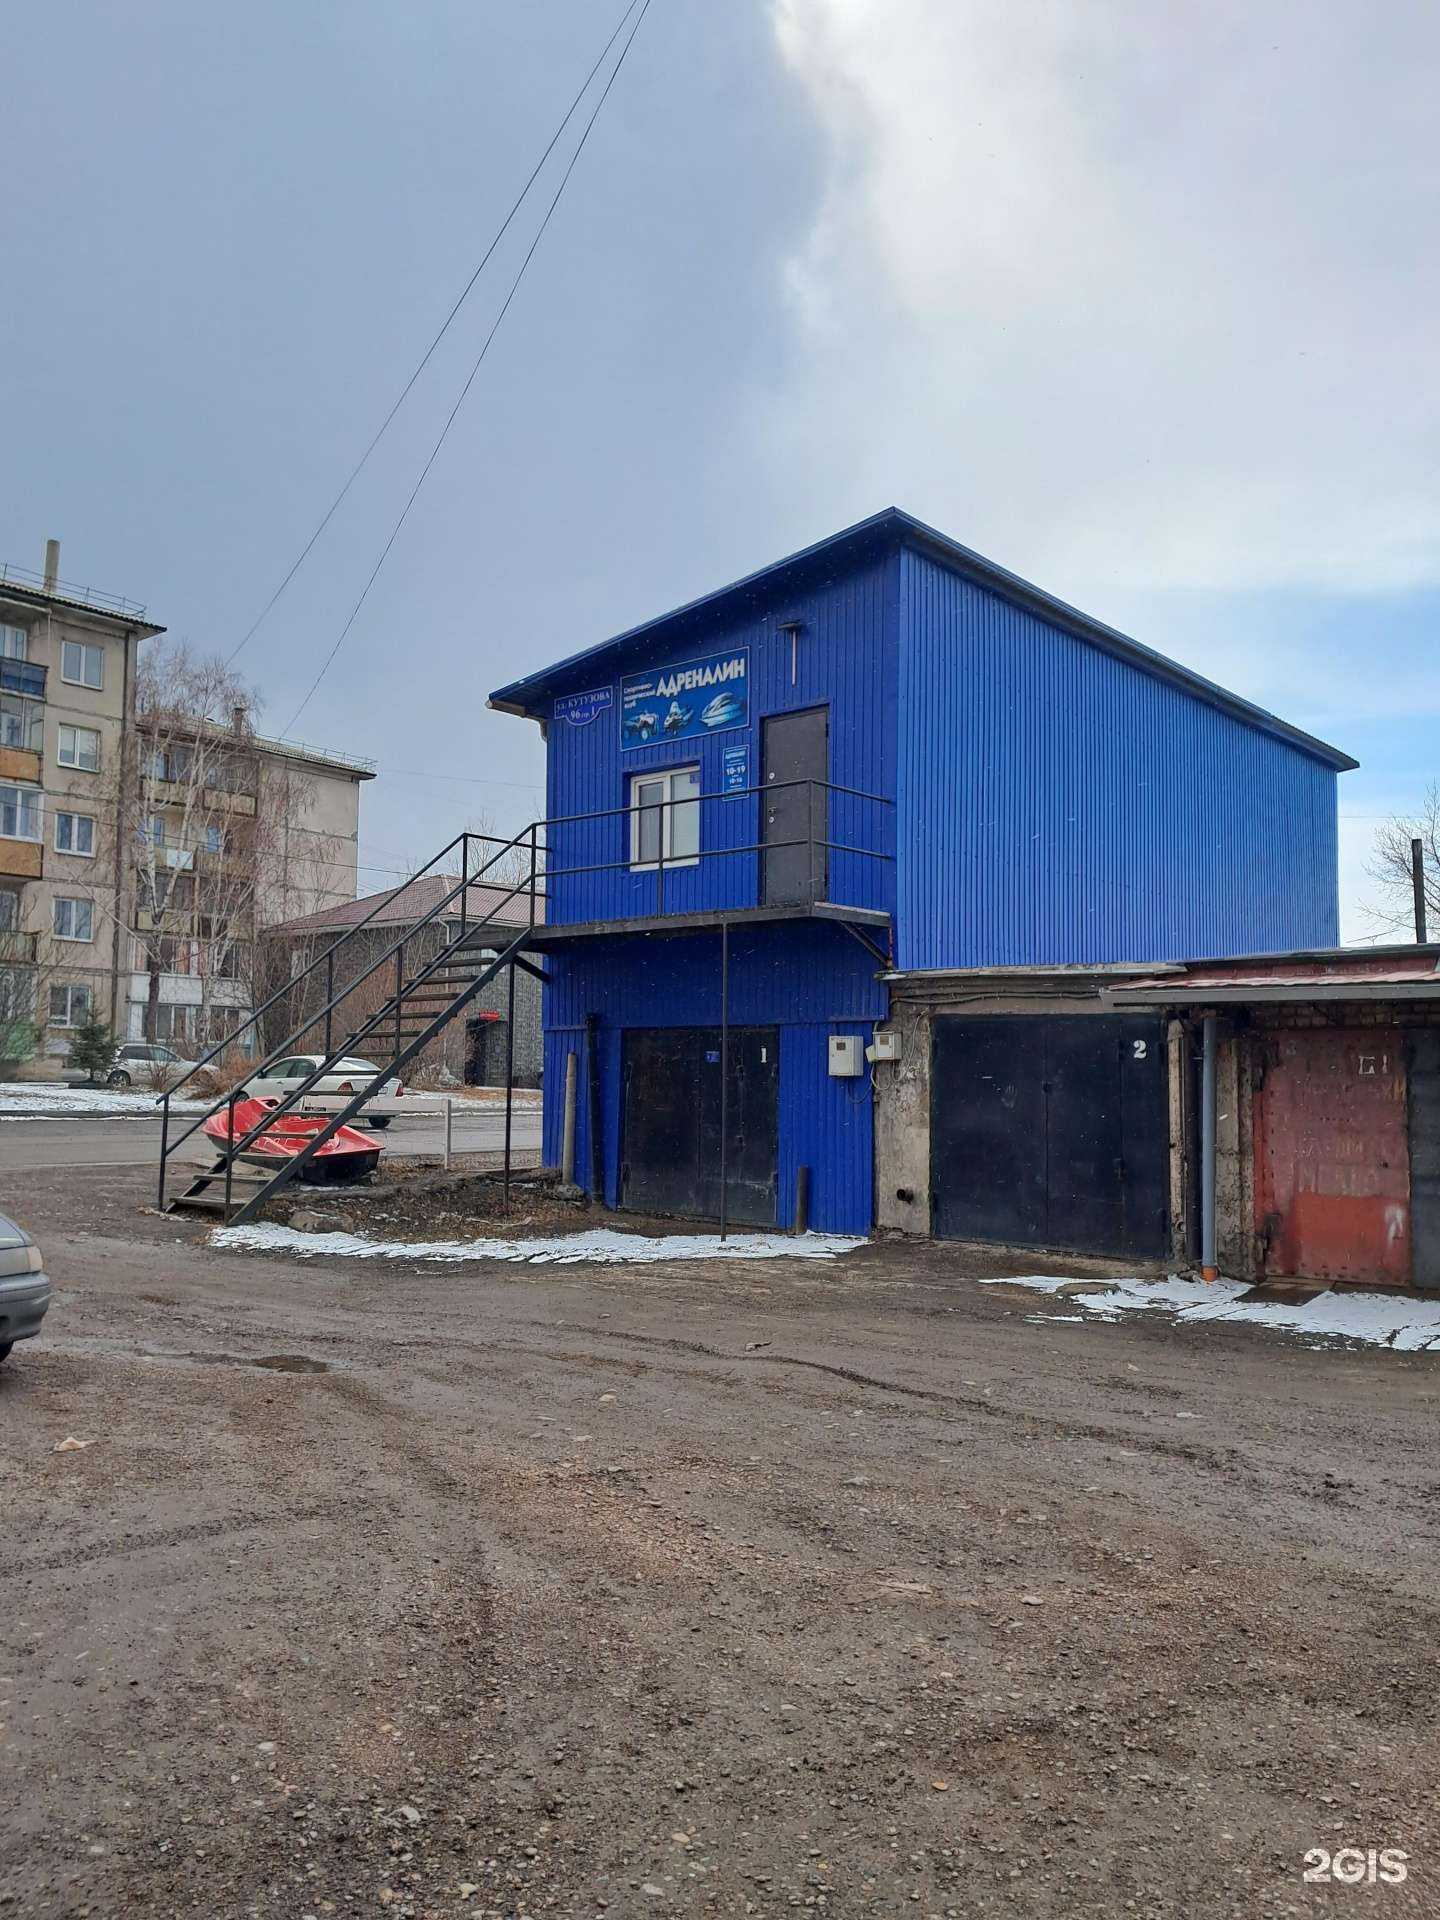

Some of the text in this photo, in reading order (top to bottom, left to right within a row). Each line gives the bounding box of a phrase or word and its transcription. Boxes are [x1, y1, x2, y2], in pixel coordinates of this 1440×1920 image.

[656, 658, 745, 697] АДРЕНАЛИН
[568, 691, 610, 708] КУТУЗОВА
[1133, 1039, 1147, 1059] 2
